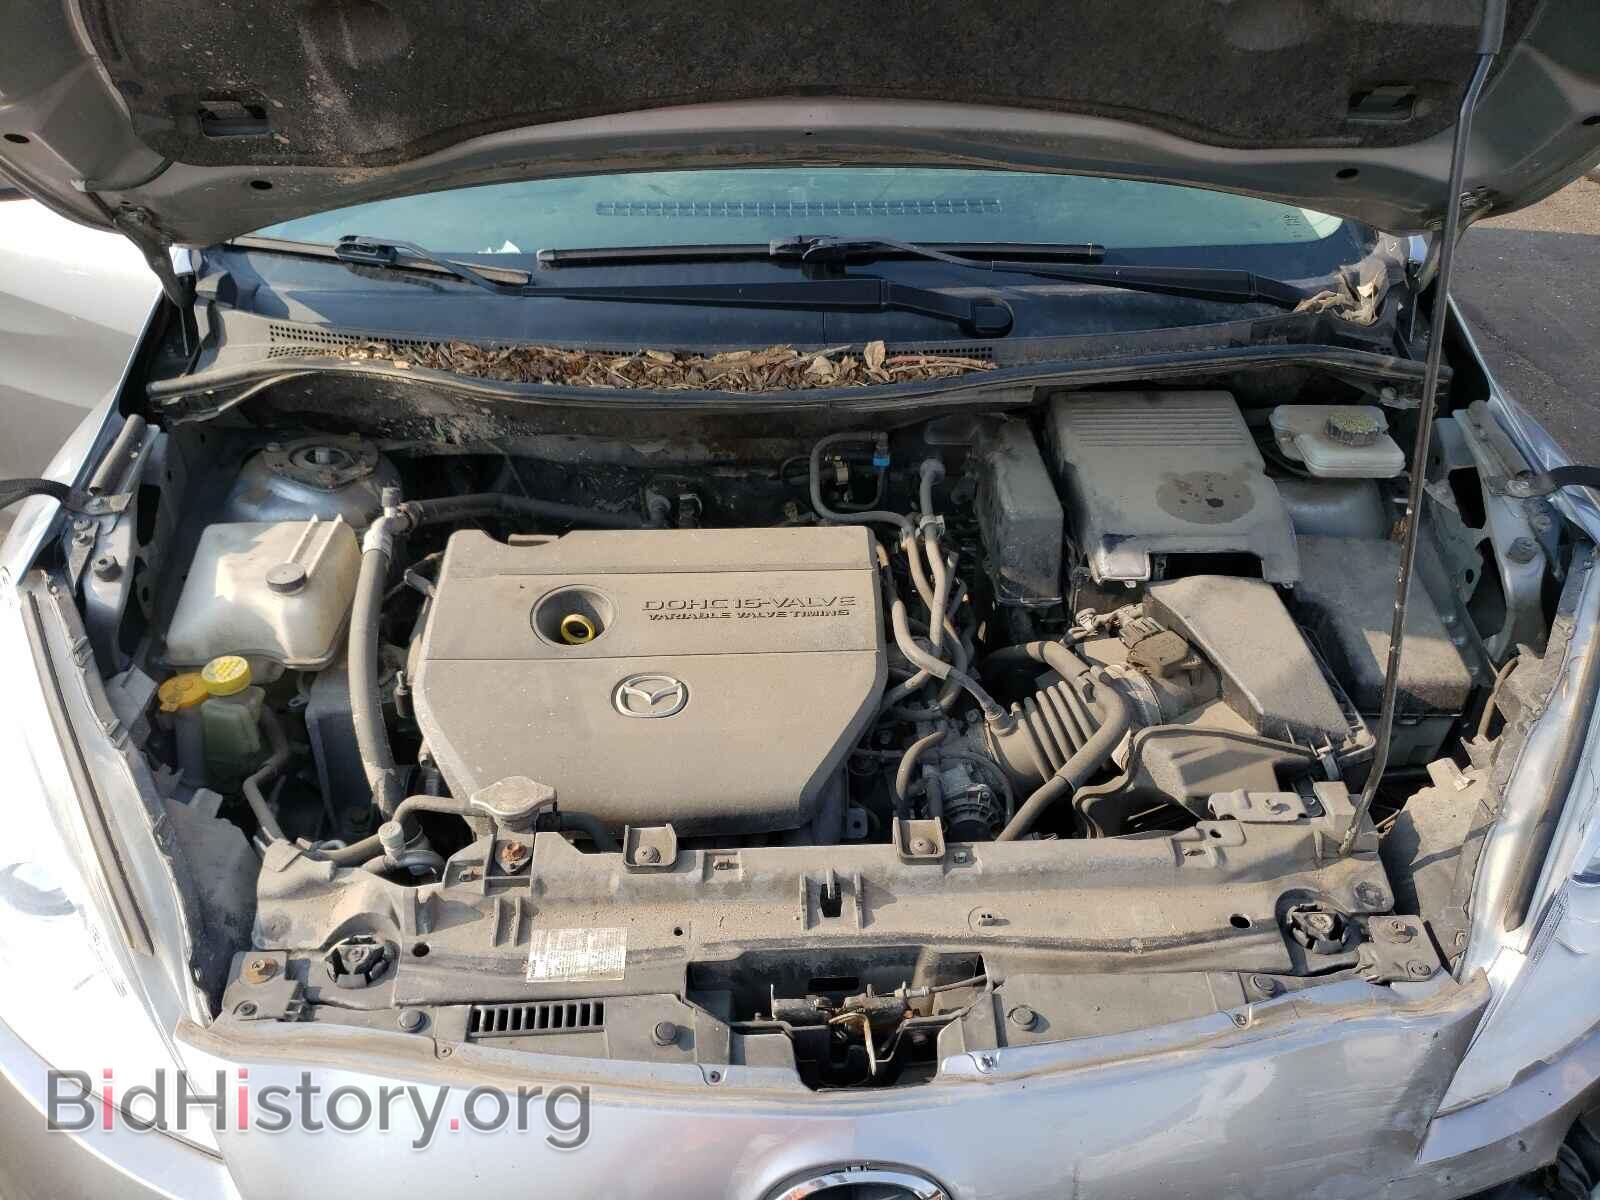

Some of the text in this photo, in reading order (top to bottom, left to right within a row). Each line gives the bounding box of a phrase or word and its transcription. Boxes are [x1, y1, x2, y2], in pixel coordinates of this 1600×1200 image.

[642, 598, 729, 611] DOHC
[649, 609, 851, 621] VARIABLE VALVE TIMING
